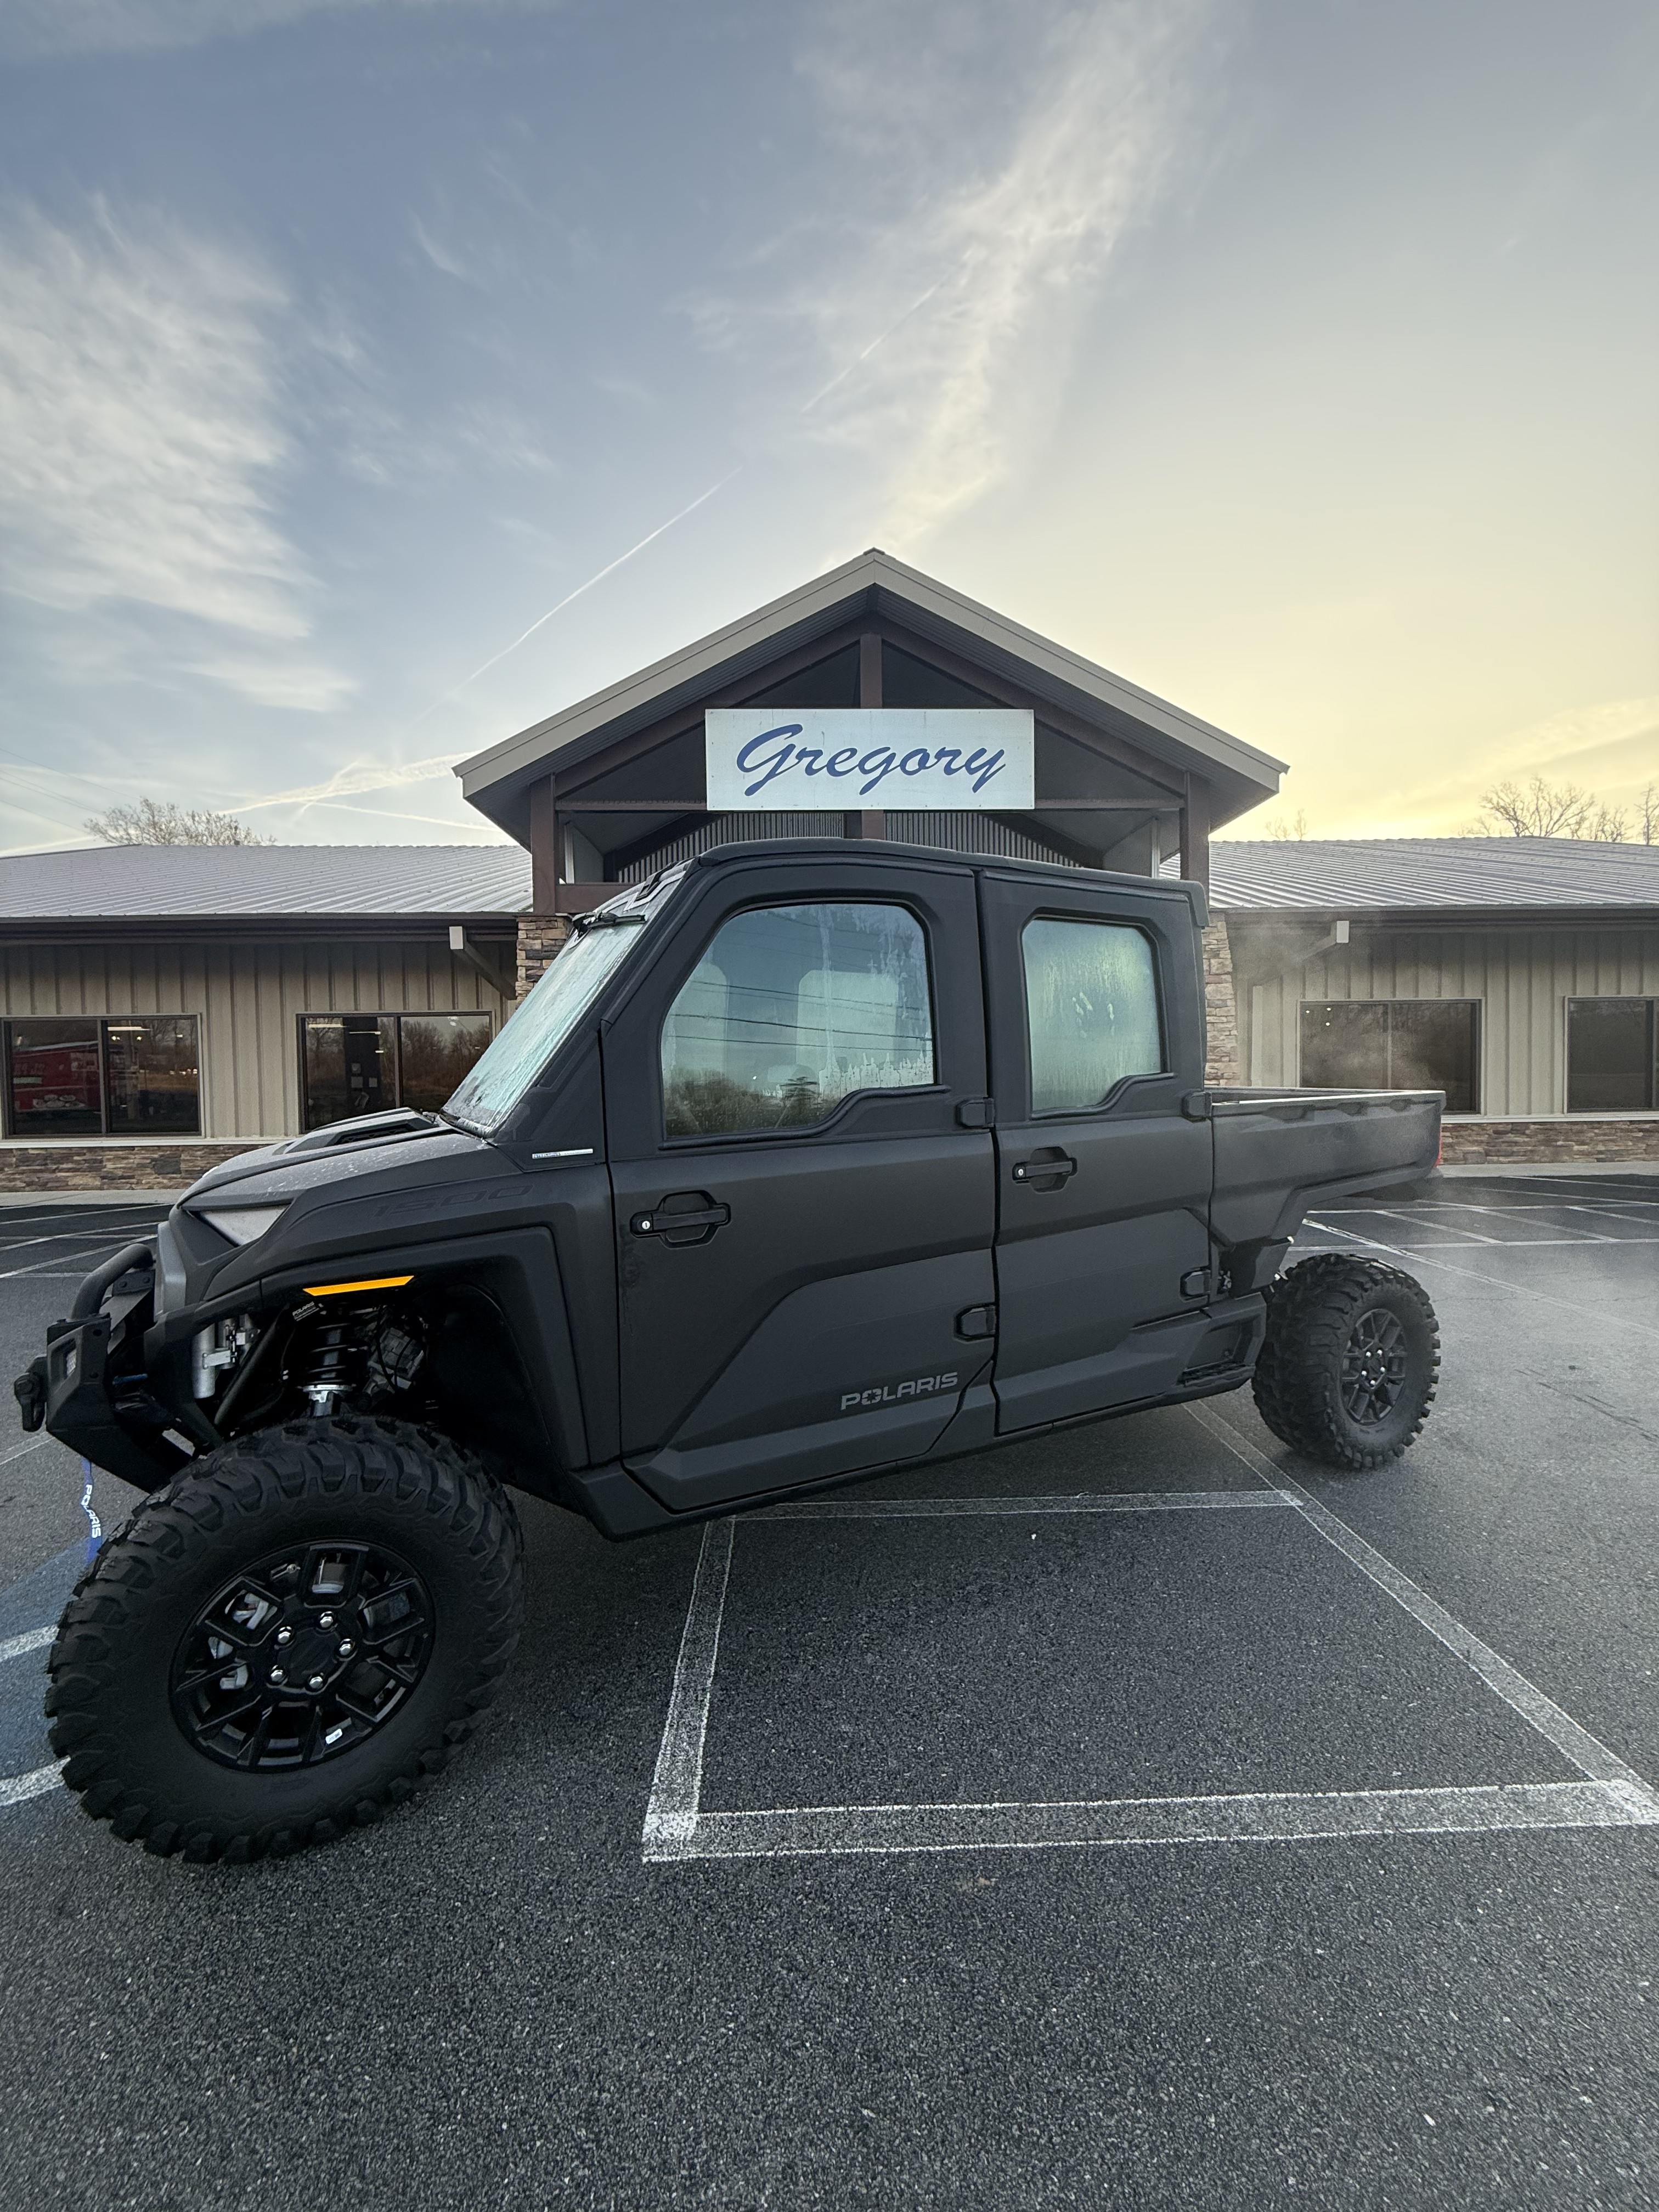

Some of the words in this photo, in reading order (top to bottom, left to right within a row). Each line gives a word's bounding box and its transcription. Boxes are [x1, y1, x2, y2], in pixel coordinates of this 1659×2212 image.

[736, 724, 1006, 797] Gregory
[374, 1184, 534, 1217] 1500
[841, 1372, 958, 1410] POLARIS
[81, 1484, 101, 1538] POLARIS
